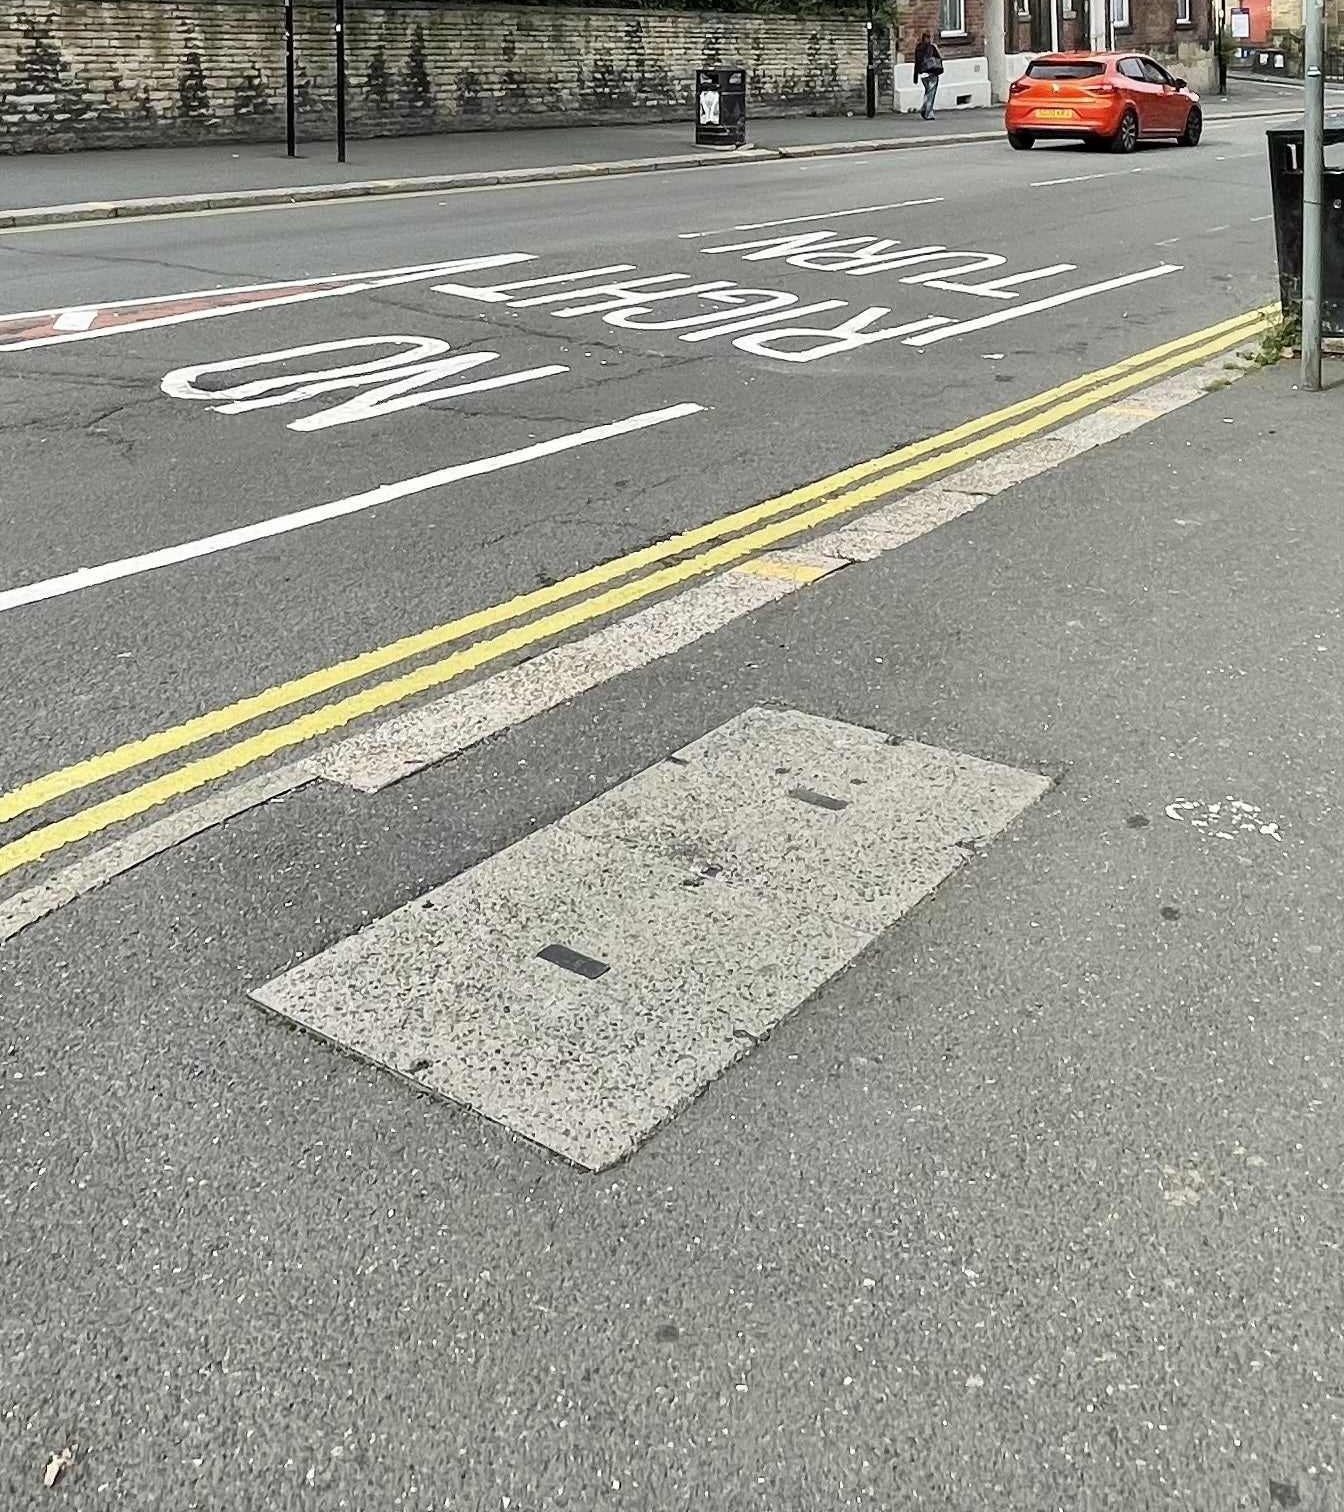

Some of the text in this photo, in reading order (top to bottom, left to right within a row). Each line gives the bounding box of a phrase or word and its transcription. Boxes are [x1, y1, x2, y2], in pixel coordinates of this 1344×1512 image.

[432, 264, 958, 363] RIGHT
[700, 231, 1077, 299] TURN
[159, 335, 571, 432] NO
